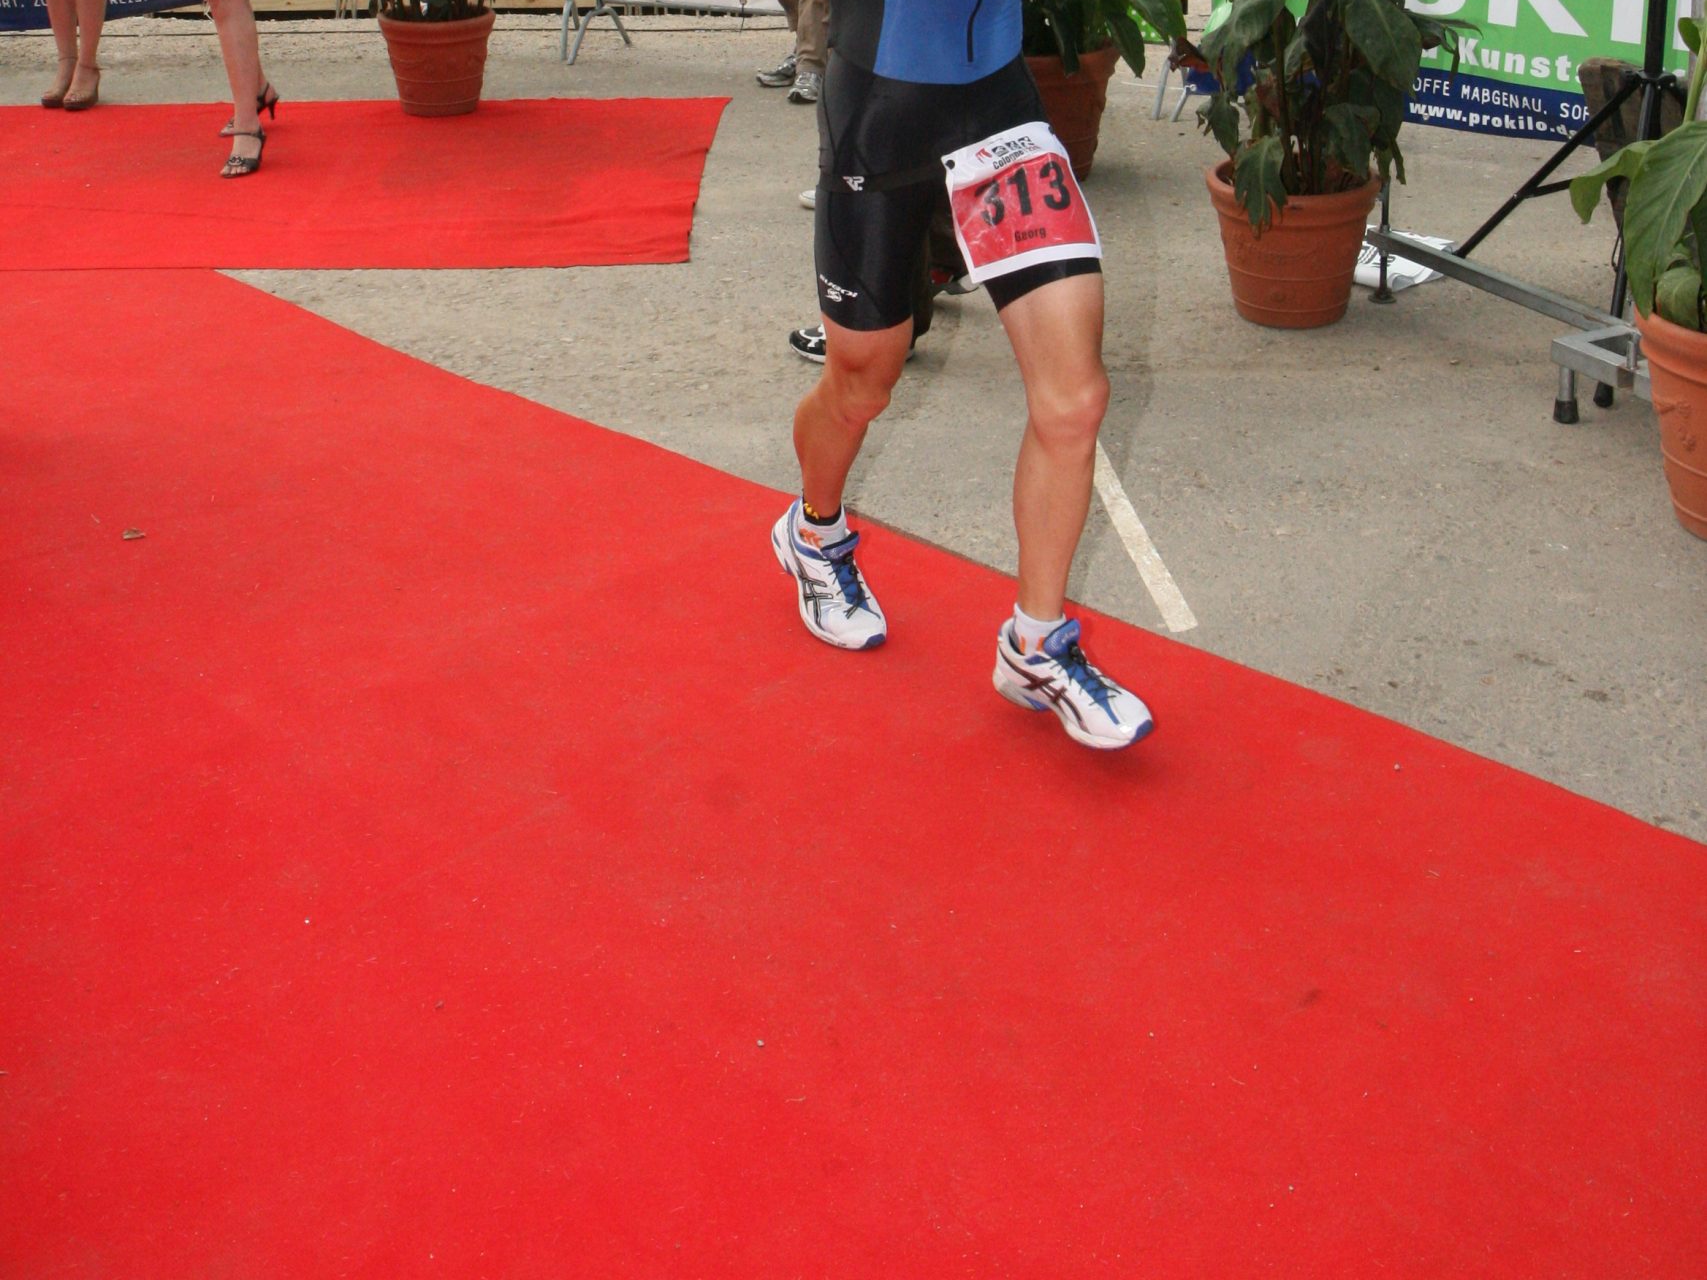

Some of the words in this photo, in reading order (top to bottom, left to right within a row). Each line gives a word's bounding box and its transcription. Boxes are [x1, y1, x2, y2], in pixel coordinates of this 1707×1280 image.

[1458, 36, 1585, 85] Kunst
[1412, 76, 1451, 98] OFFE
[974, 160, 1072, 228] 313
[1014, 226, 1047, 243] Georg
